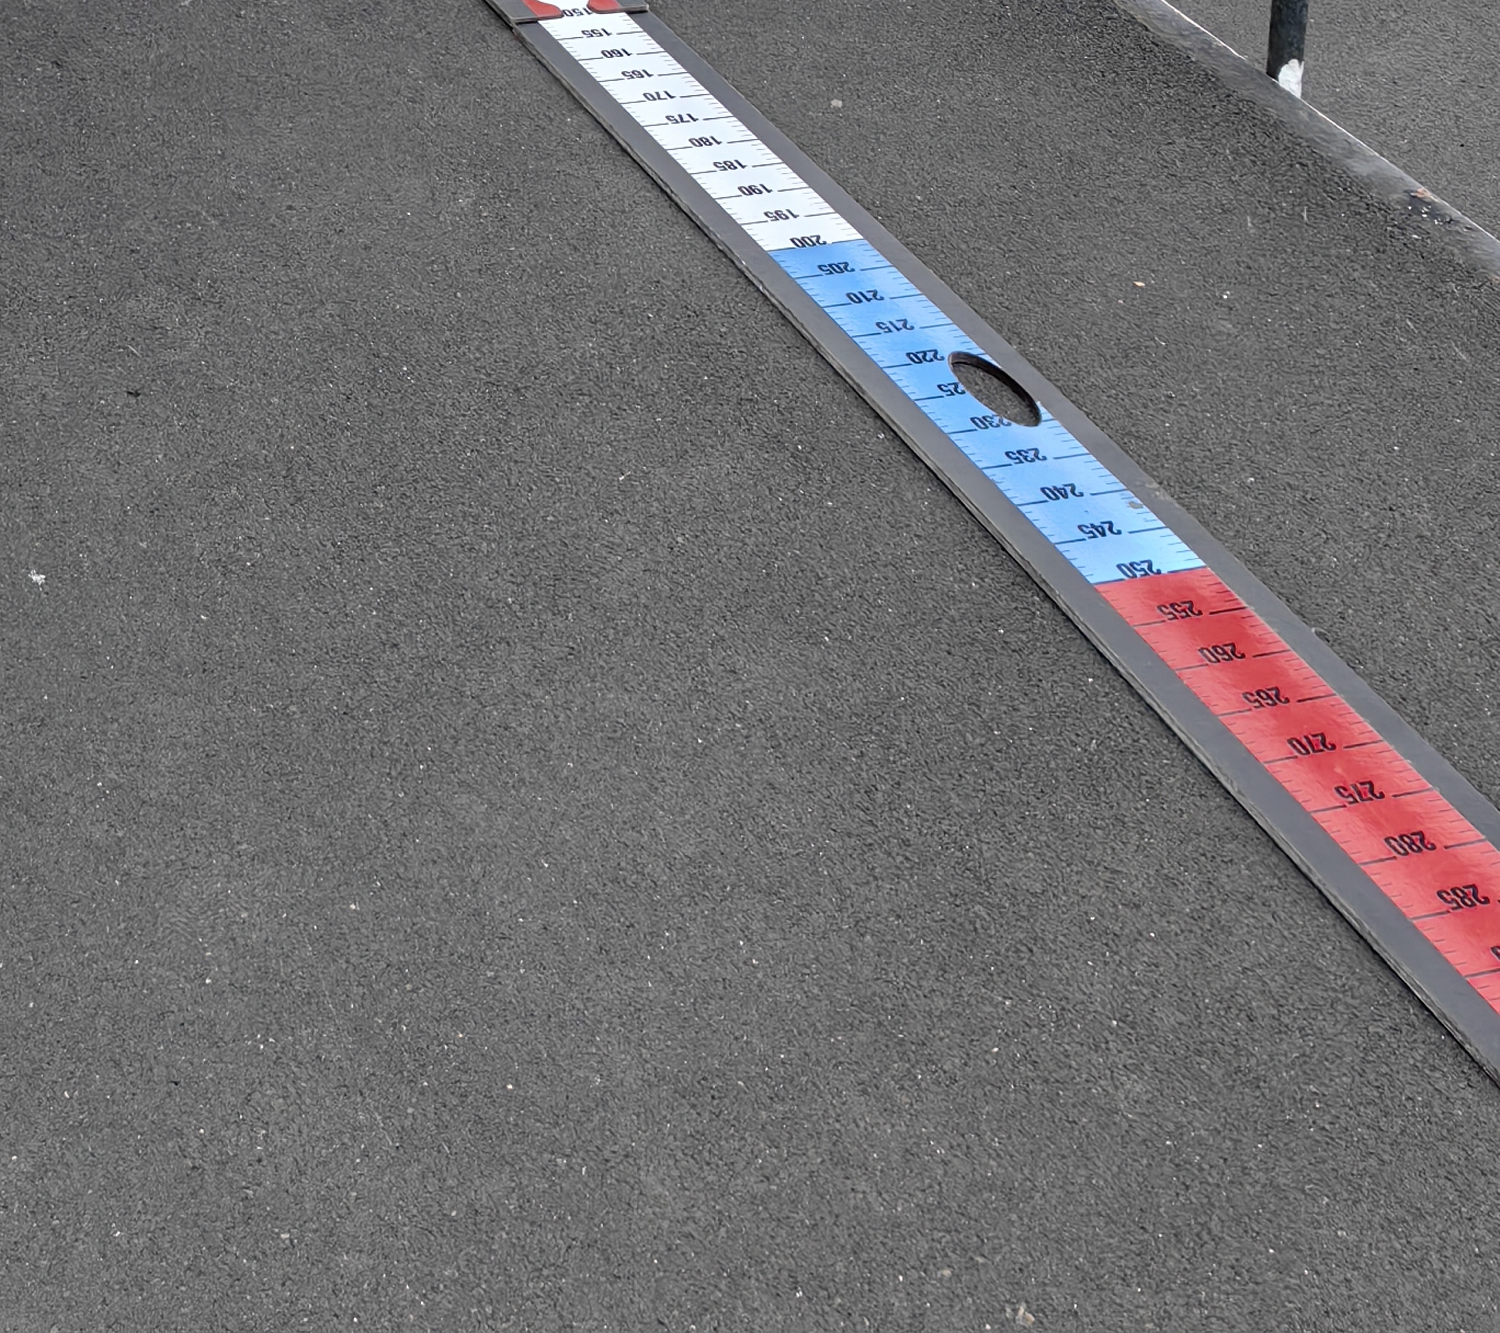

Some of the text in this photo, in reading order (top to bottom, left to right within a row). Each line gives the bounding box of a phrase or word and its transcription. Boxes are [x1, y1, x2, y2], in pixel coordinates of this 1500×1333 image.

[562, 7, 594, 17] 150
[581, 28, 613, 38] 155
[600, 48, 633, 59] 160
[621, 69, 654, 80] 165
[643, 90, 676, 102] 170
[665, 113, 699, 125] 175
[688, 135, 723, 148] 180
[713, 159, 748, 172] 185
[737, 183, 773, 196] 190
[763, 208, 800, 221] 195
[789, 234, 827, 248] 200
[817, 261, 855, 276] 205
[845, 289, 885, 304] 210
[875, 318, 915, 334] 215
[905, 349, 945, 364] 220
[1004, 448, 1048, 465] 235
[1040, 483, 1084, 502] 240
[1077, 520, 1123, 540] 245
[1116, 559, 1162, 580] 250
[1156, 600, 1204, 621] 255
[1198, 642, 1246, 664] 260
[1242, 686, 1291, 710] 265
[1286, 732, 1337, 757] 270
[1333, 780, 1386, 805] 275
[1383, 830, 1437, 857] 280
[1435, 884, 1491, 911] 285
